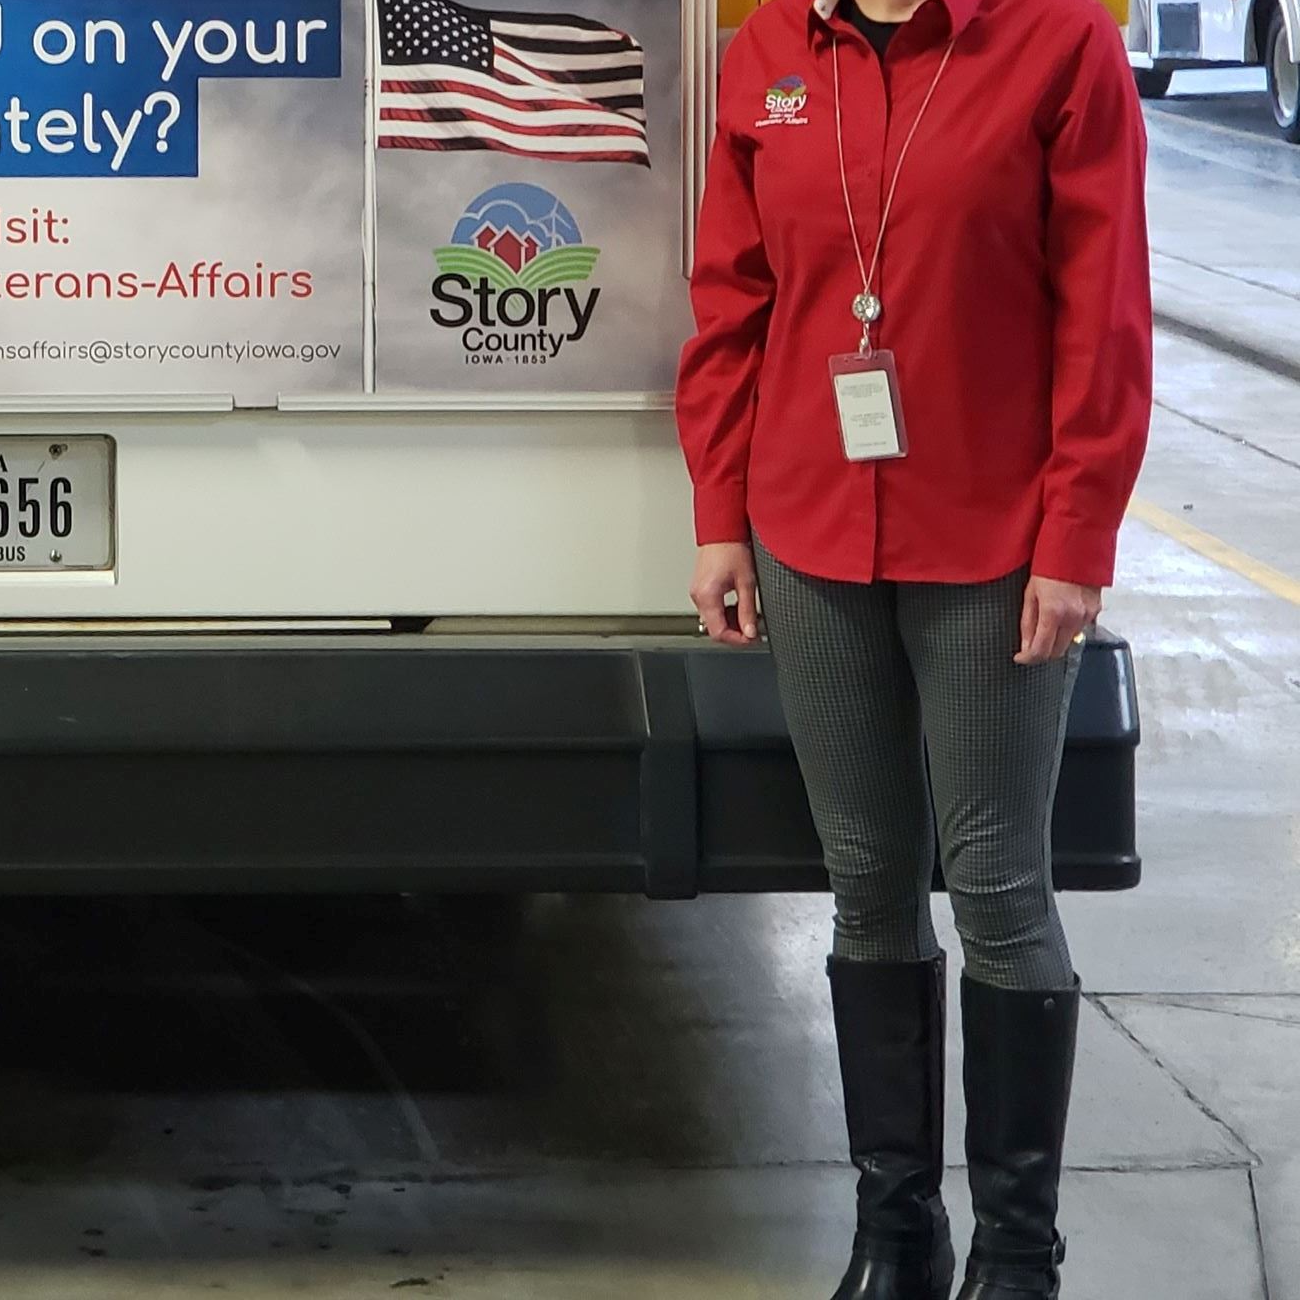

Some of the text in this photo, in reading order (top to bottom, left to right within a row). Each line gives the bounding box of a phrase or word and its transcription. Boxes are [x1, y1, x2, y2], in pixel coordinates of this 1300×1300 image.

[33, 20, 126, 64] on
[152, 19, 327, 81] your
[765, 94, 807, 111] Story
[429, 272, 601, 341] Story
[462, 327, 565, 358] County
[465, 354, 548, 365] IOWA 1853
